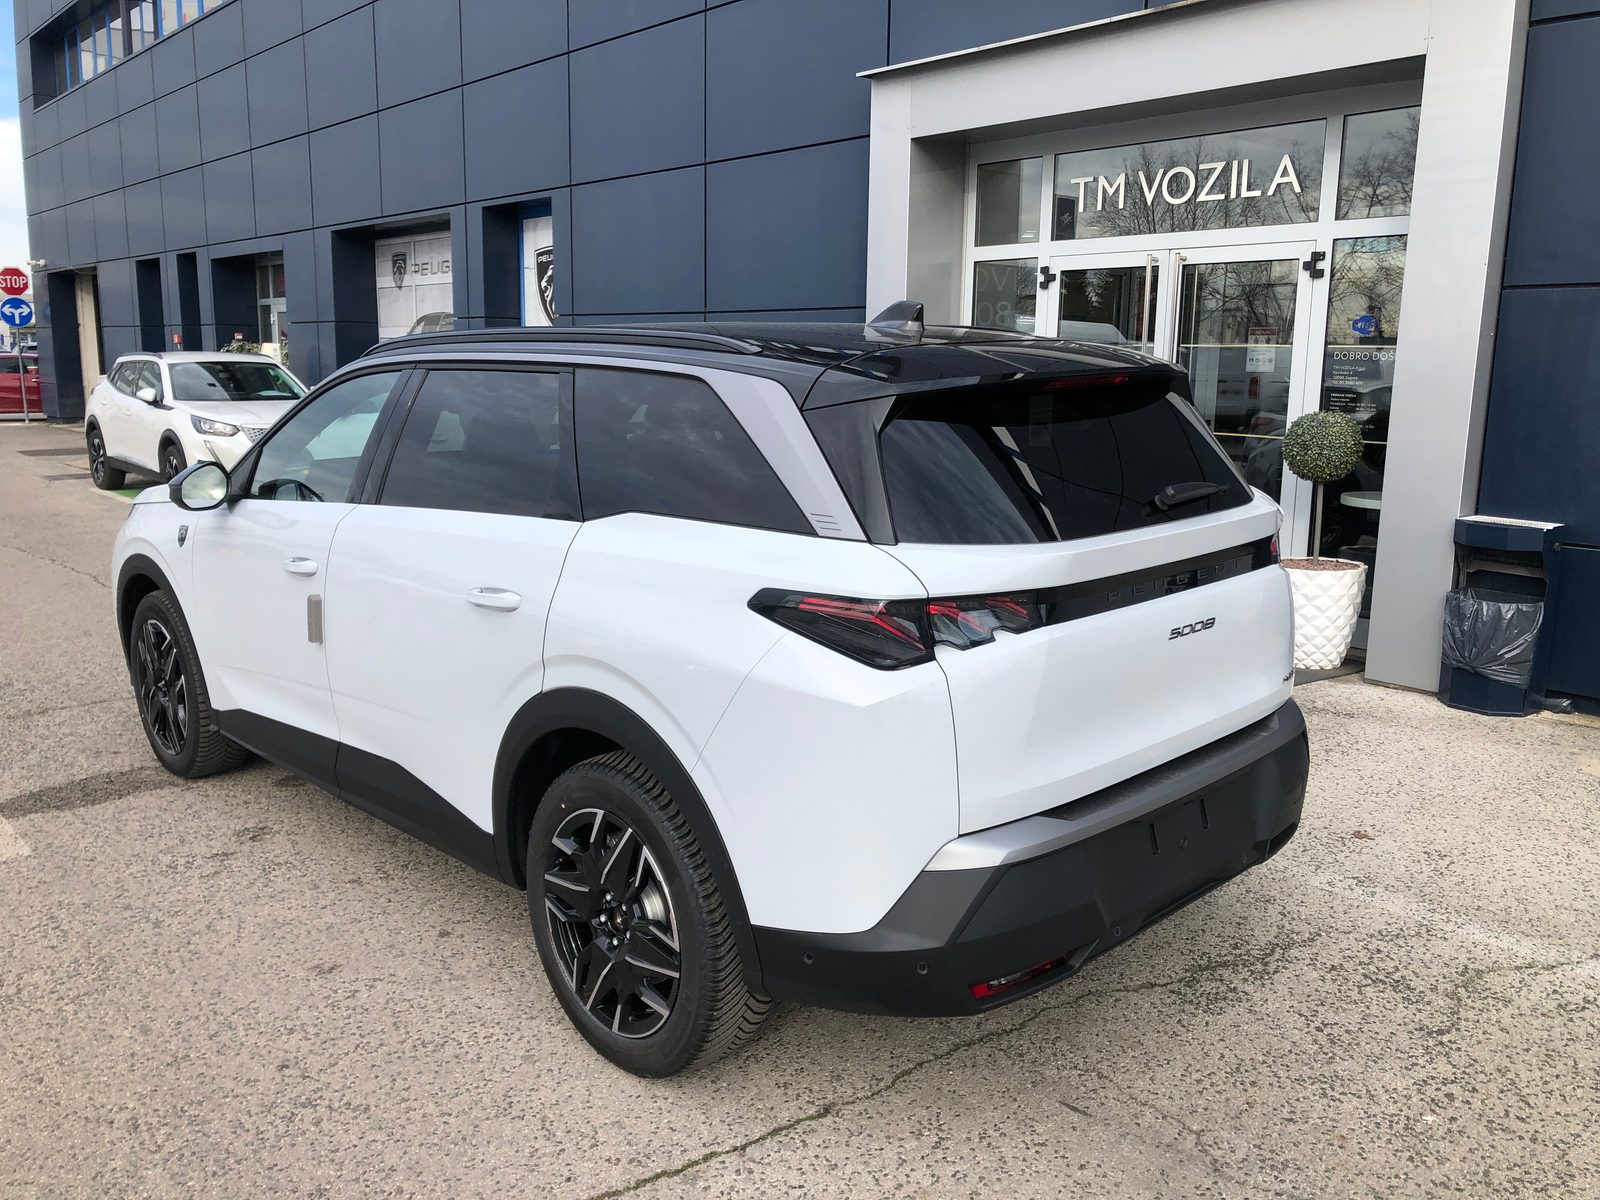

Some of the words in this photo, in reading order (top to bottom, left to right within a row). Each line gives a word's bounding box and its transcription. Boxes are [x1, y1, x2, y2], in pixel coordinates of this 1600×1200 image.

[1070, 173, 1126, 213] TM
[1138, 154, 1302, 207] VOZILA
[0, 275, 27, 288] STOP
[1333, 351, 1370, 360] DOBRO
[1168, 617, 1216, 640] 5008
